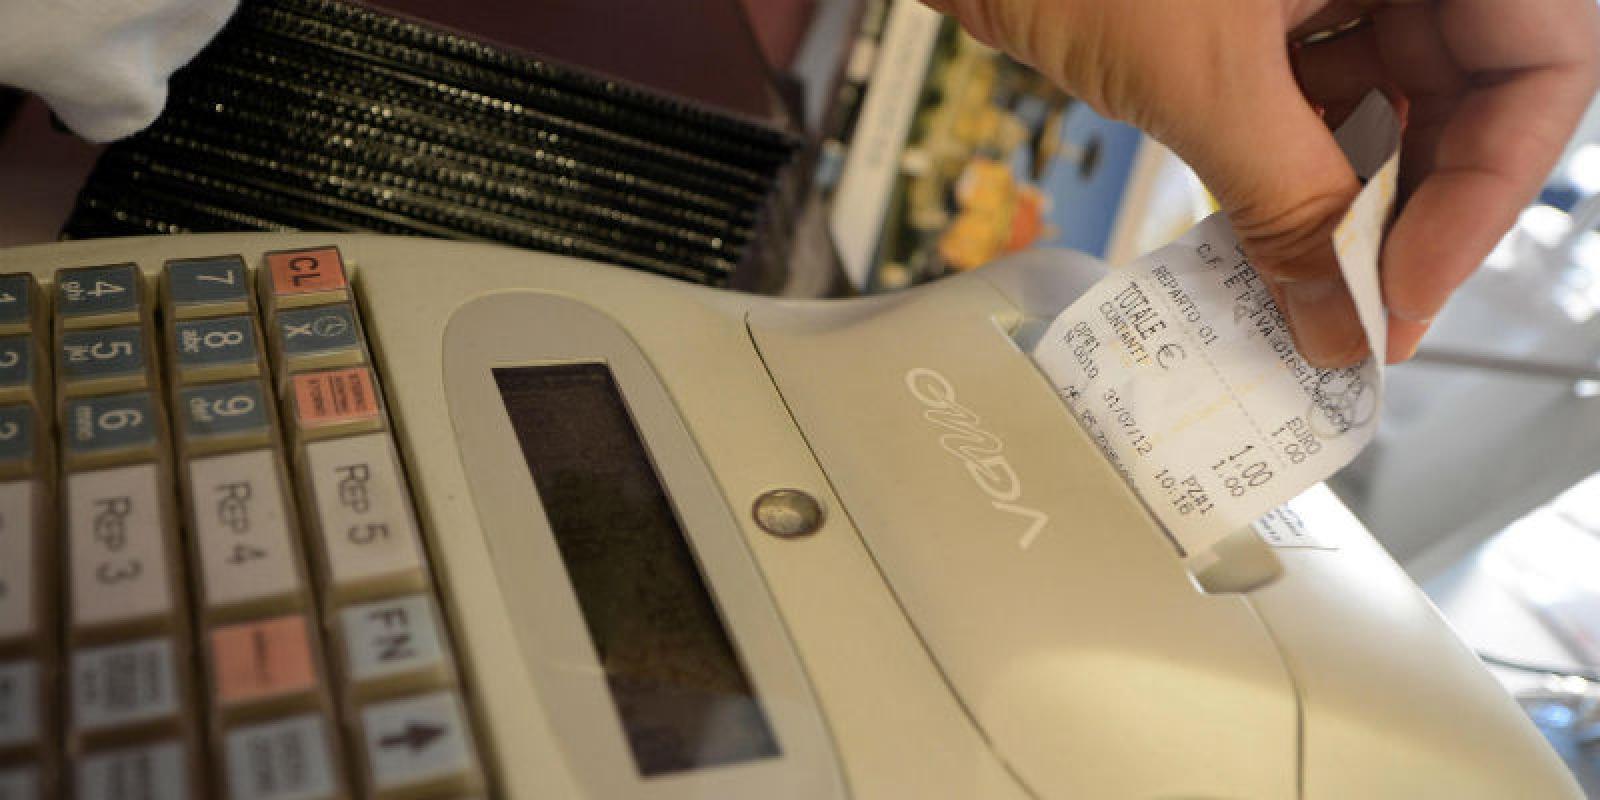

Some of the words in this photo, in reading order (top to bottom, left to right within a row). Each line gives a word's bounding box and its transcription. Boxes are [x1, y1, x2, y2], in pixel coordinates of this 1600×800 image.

[195, 269, 235, 286] 7
[288, 257, 321, 287] CL
[87, 281, 127, 297] 4
[90, 341, 132, 359] 5
[203, 330, 243, 348] 8
[1152, 264, 1202, 323] REPARTO
[1272, 427, 1307, 464] 1.00
[1113, 281, 1167, 341] TOTALE
[1156, 343, 1187, 371] €
[1228, 445, 1274, 488] 1.00
[213, 396, 255, 417] 9
[1099, 300, 1152, 365] CONTANTI
[1211, 458, 1245, 498] 1.00
[98, 409, 144, 431] 6
[1104, 388, 1153, 457] 31/07/12
[1285, 415, 1322, 455] EURO
[347, 522, 391, 546] 5
[225, 545, 270, 564] 4
[95, 559, 145, 586] 3
[364, 606, 416, 663] FN
